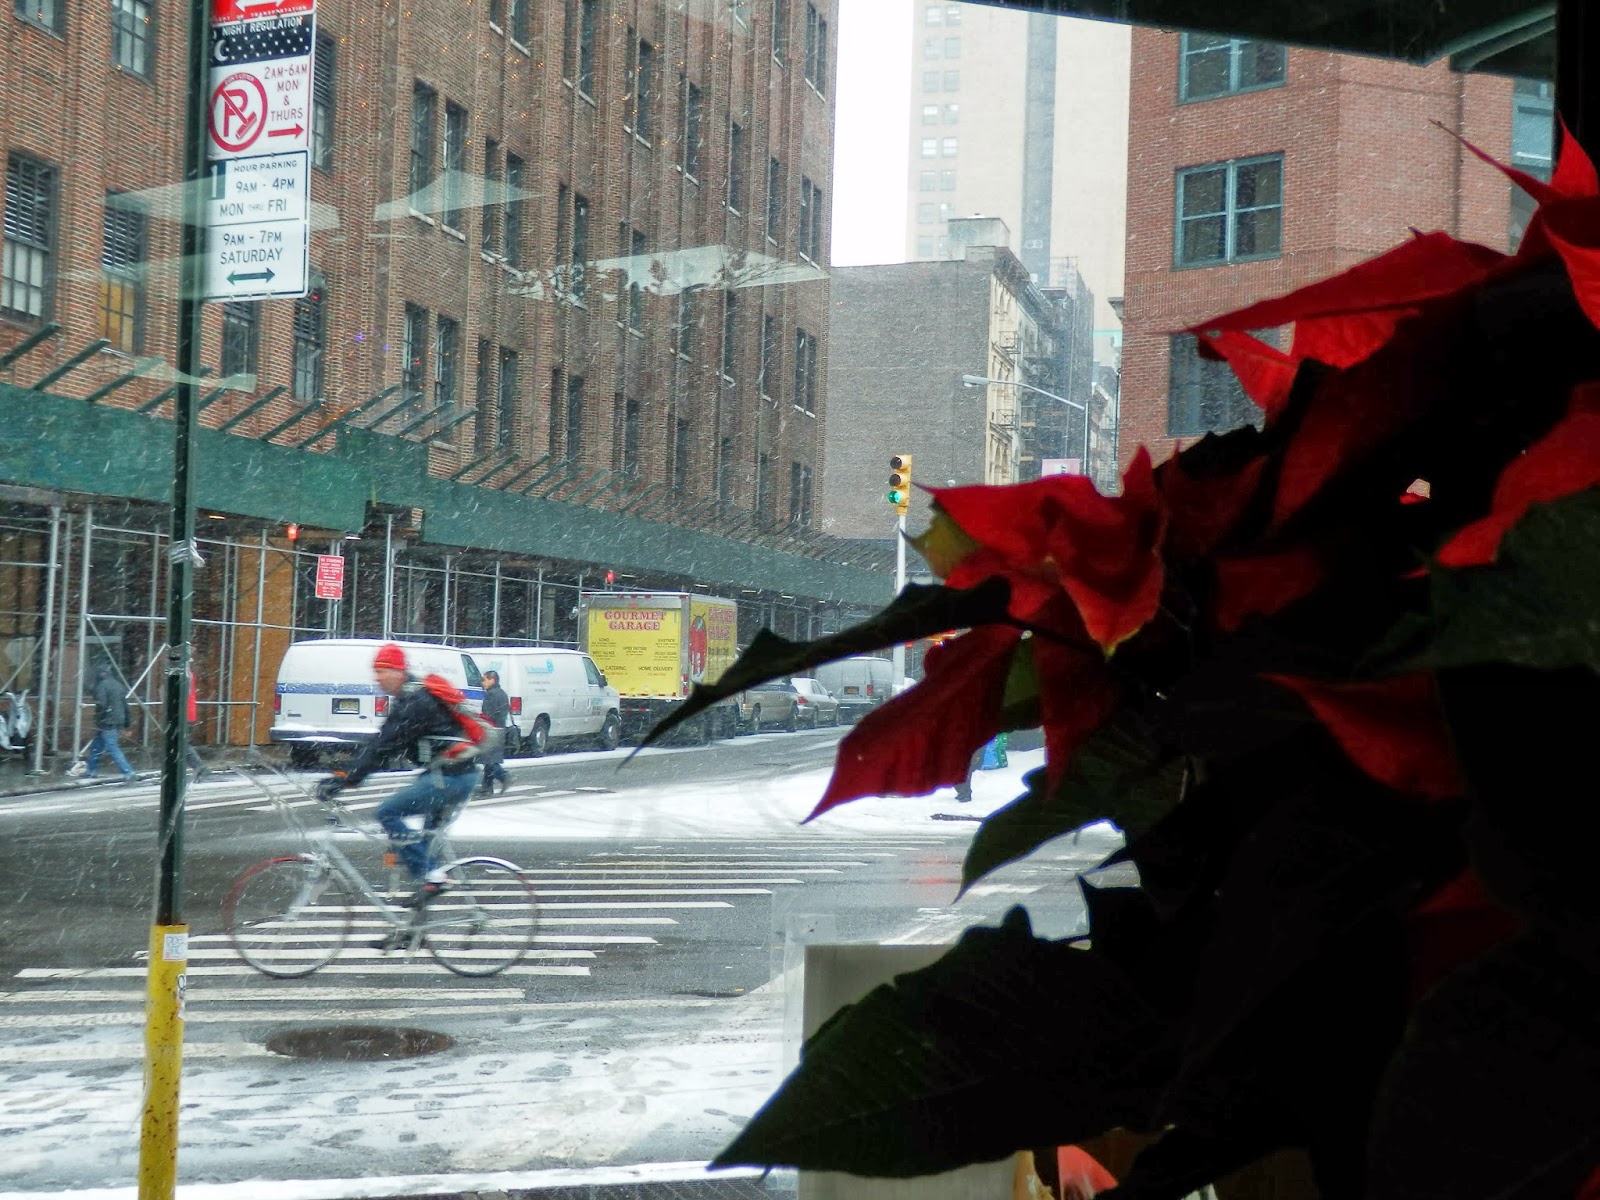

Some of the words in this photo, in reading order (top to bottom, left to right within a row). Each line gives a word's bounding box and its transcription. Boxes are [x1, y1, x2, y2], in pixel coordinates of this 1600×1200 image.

[222, 23, 247, 37] NIGHT
[249, 17, 304, 33] REGULATION
[264, 64, 308, 79] 2AM-6AM
[277, 80, 299, 92] MON
[283, 95, 290, 106] &
[271, 107, 303, 121] THURS
[234, 164, 258, 173] HOUR
[260, 160, 297, 170] PARKING
[236, 181, 258, 193] 9AM
[272, 178, 295, 191] 4PM
[220, 202, 244, 217] MON
[268, 198, 287, 212] FRI
[223, 233, 245, 246] 9AM
[259, 230, 282, 244] 7PM
[220, 247, 283, 265] SATURDAY
[604, 610, 667, 621] GOURMET
[609, 621, 660, 631] GARAGE
